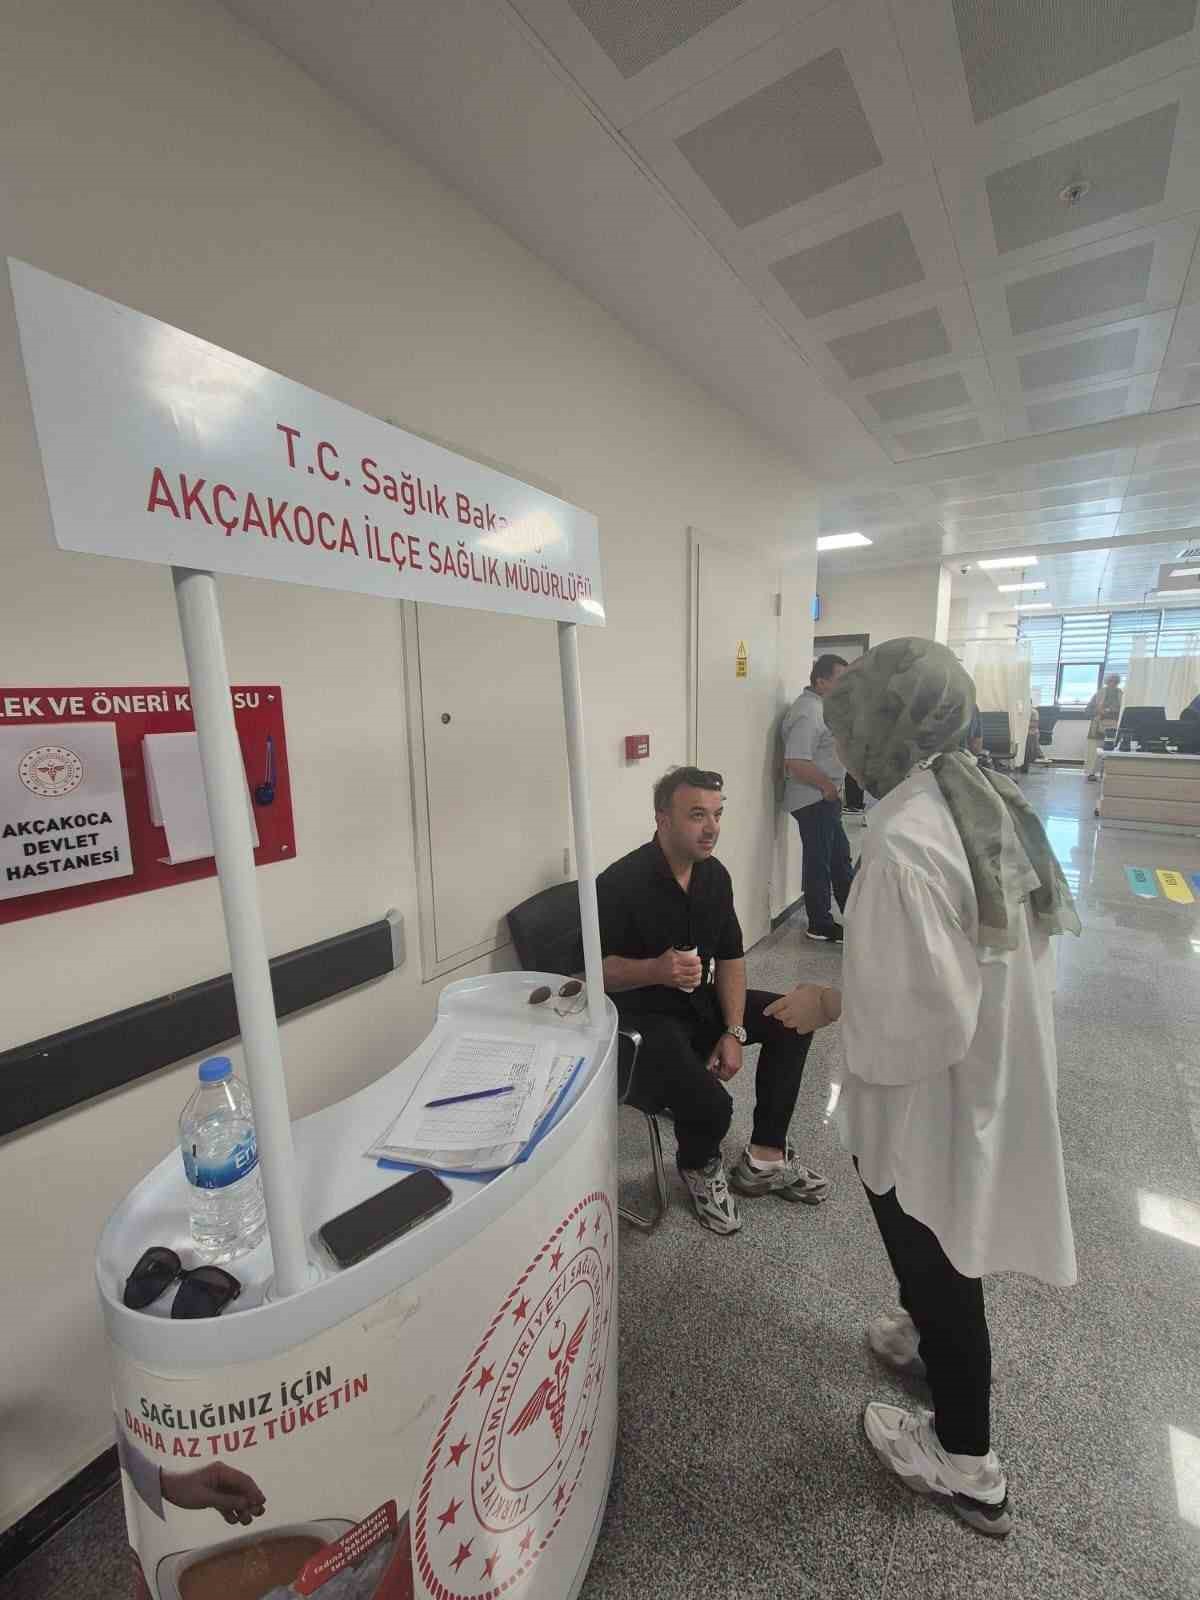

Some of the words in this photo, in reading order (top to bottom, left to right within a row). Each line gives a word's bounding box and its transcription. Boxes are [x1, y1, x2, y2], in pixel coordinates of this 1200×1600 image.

[276, 423, 351, 488] T.C.
[360, 458, 449, 519] Sağlık
[147, 466, 360, 557] AKÇAKOCA
[363, 514, 424, 572] İLÇE
[428, 540, 502, 587] SAĞLIK
[504, 557, 593, 602] MÜDÜRLÜĞÜ
[0, 696, 45, 718] EK
[47, 696, 86, 716] VE
[91, 691, 169, 716] ÖNERİ
[1, 811, 113, 839] AKÇAKOCA
[23, 832, 101, 858] DEVLET
[5, 846, 121, 882] HASTANESİ
[124, 1407, 167, 1454] DAHA
[173, 1437, 202, 1457] AZ
[207, 1426, 258, 1456] TUZ
[263, 1373, 369, 1440] TÜKETİN
[140, 1392, 273, 1430] SAĞLIĞINIZ
[281, 1365, 332, 1407] İÇİN
